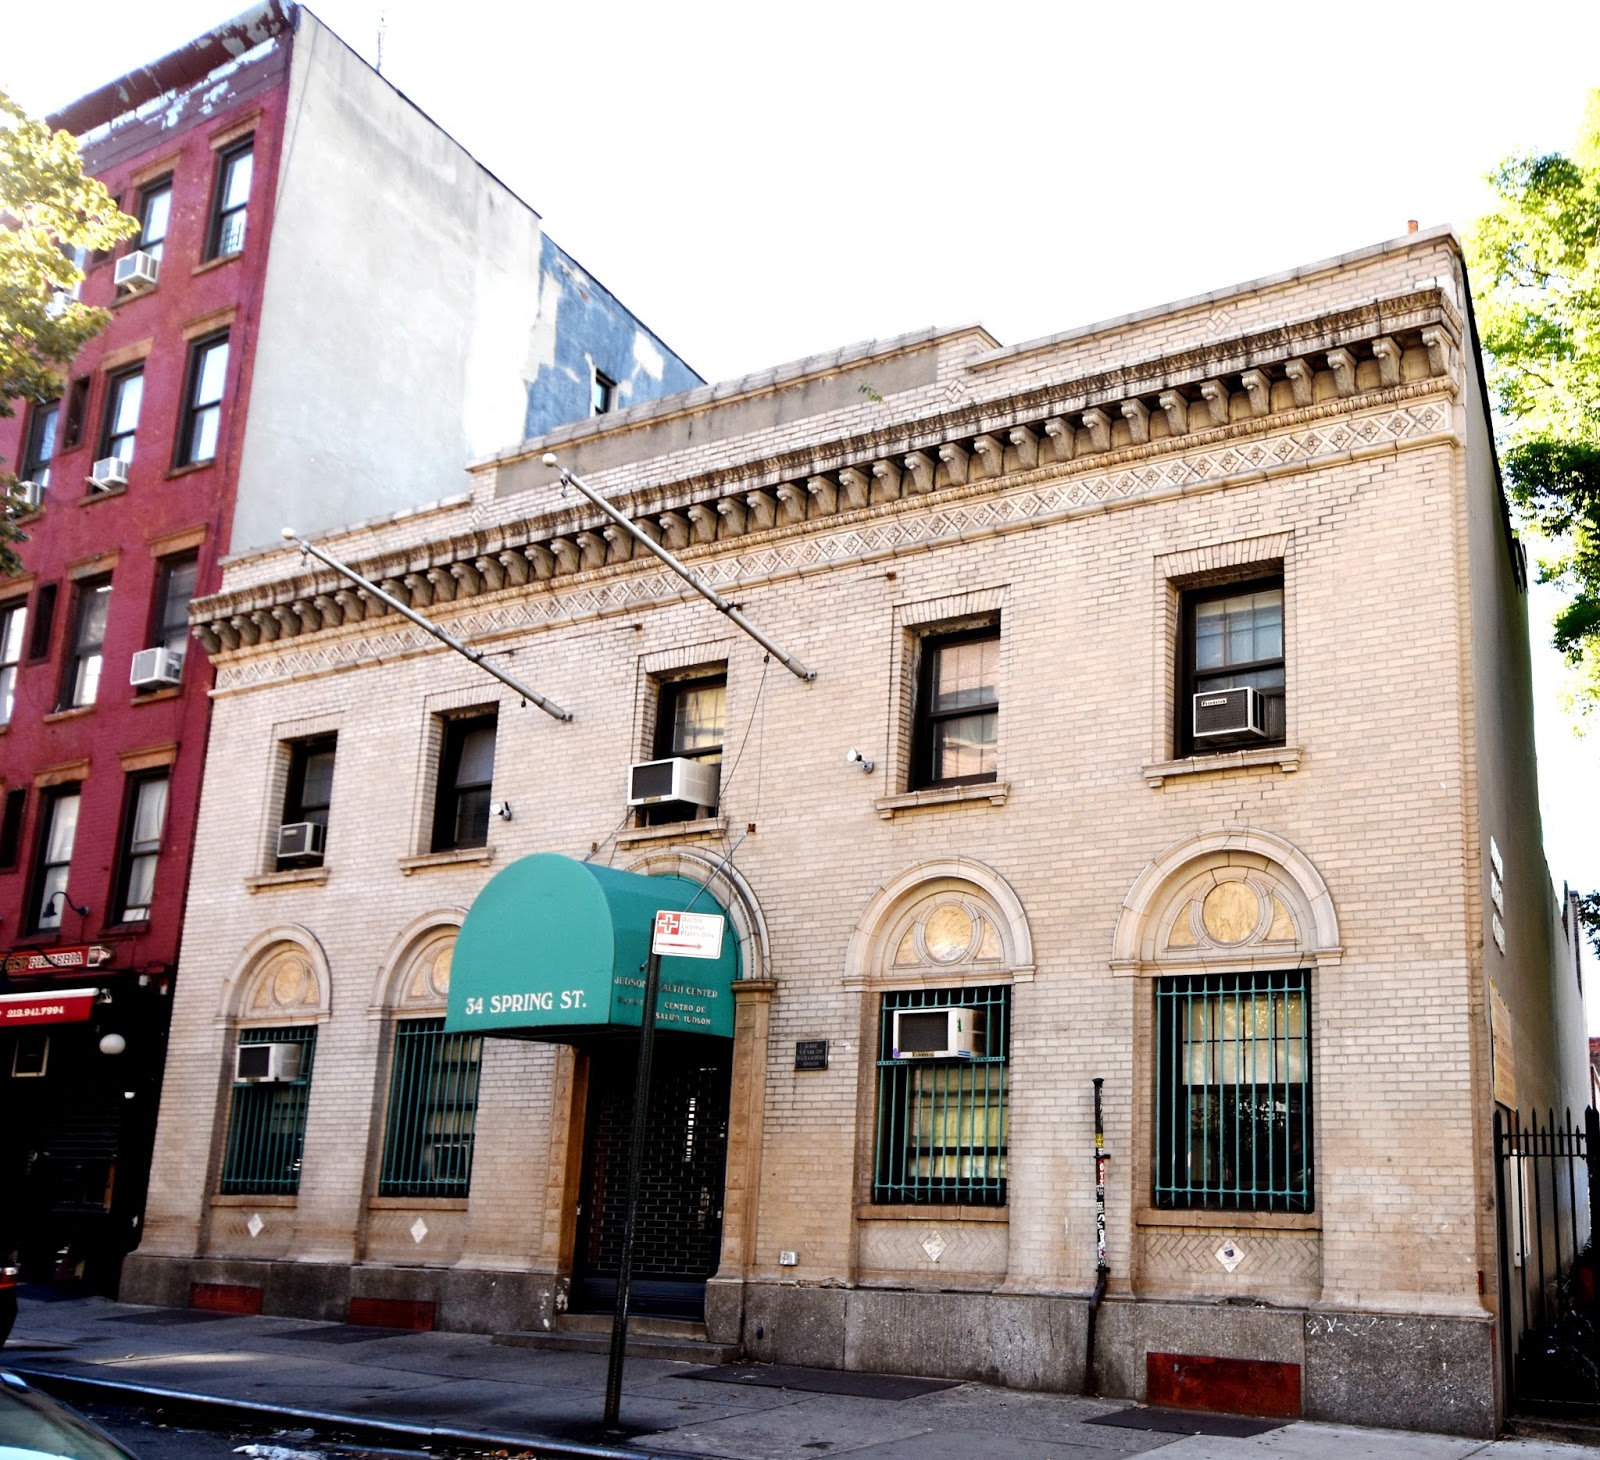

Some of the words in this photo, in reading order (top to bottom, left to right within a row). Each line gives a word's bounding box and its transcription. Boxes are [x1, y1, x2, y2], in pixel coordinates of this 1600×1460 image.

[686, 986, 718, 998] CENTER
[464, 997, 483, 1015] 34
[489, 992, 553, 1014] SPRING
[560, 989, 587, 1009] ST.
[664, 1001, 693, 1012] CENTRO
[695, 1005, 706, 1014] DE
